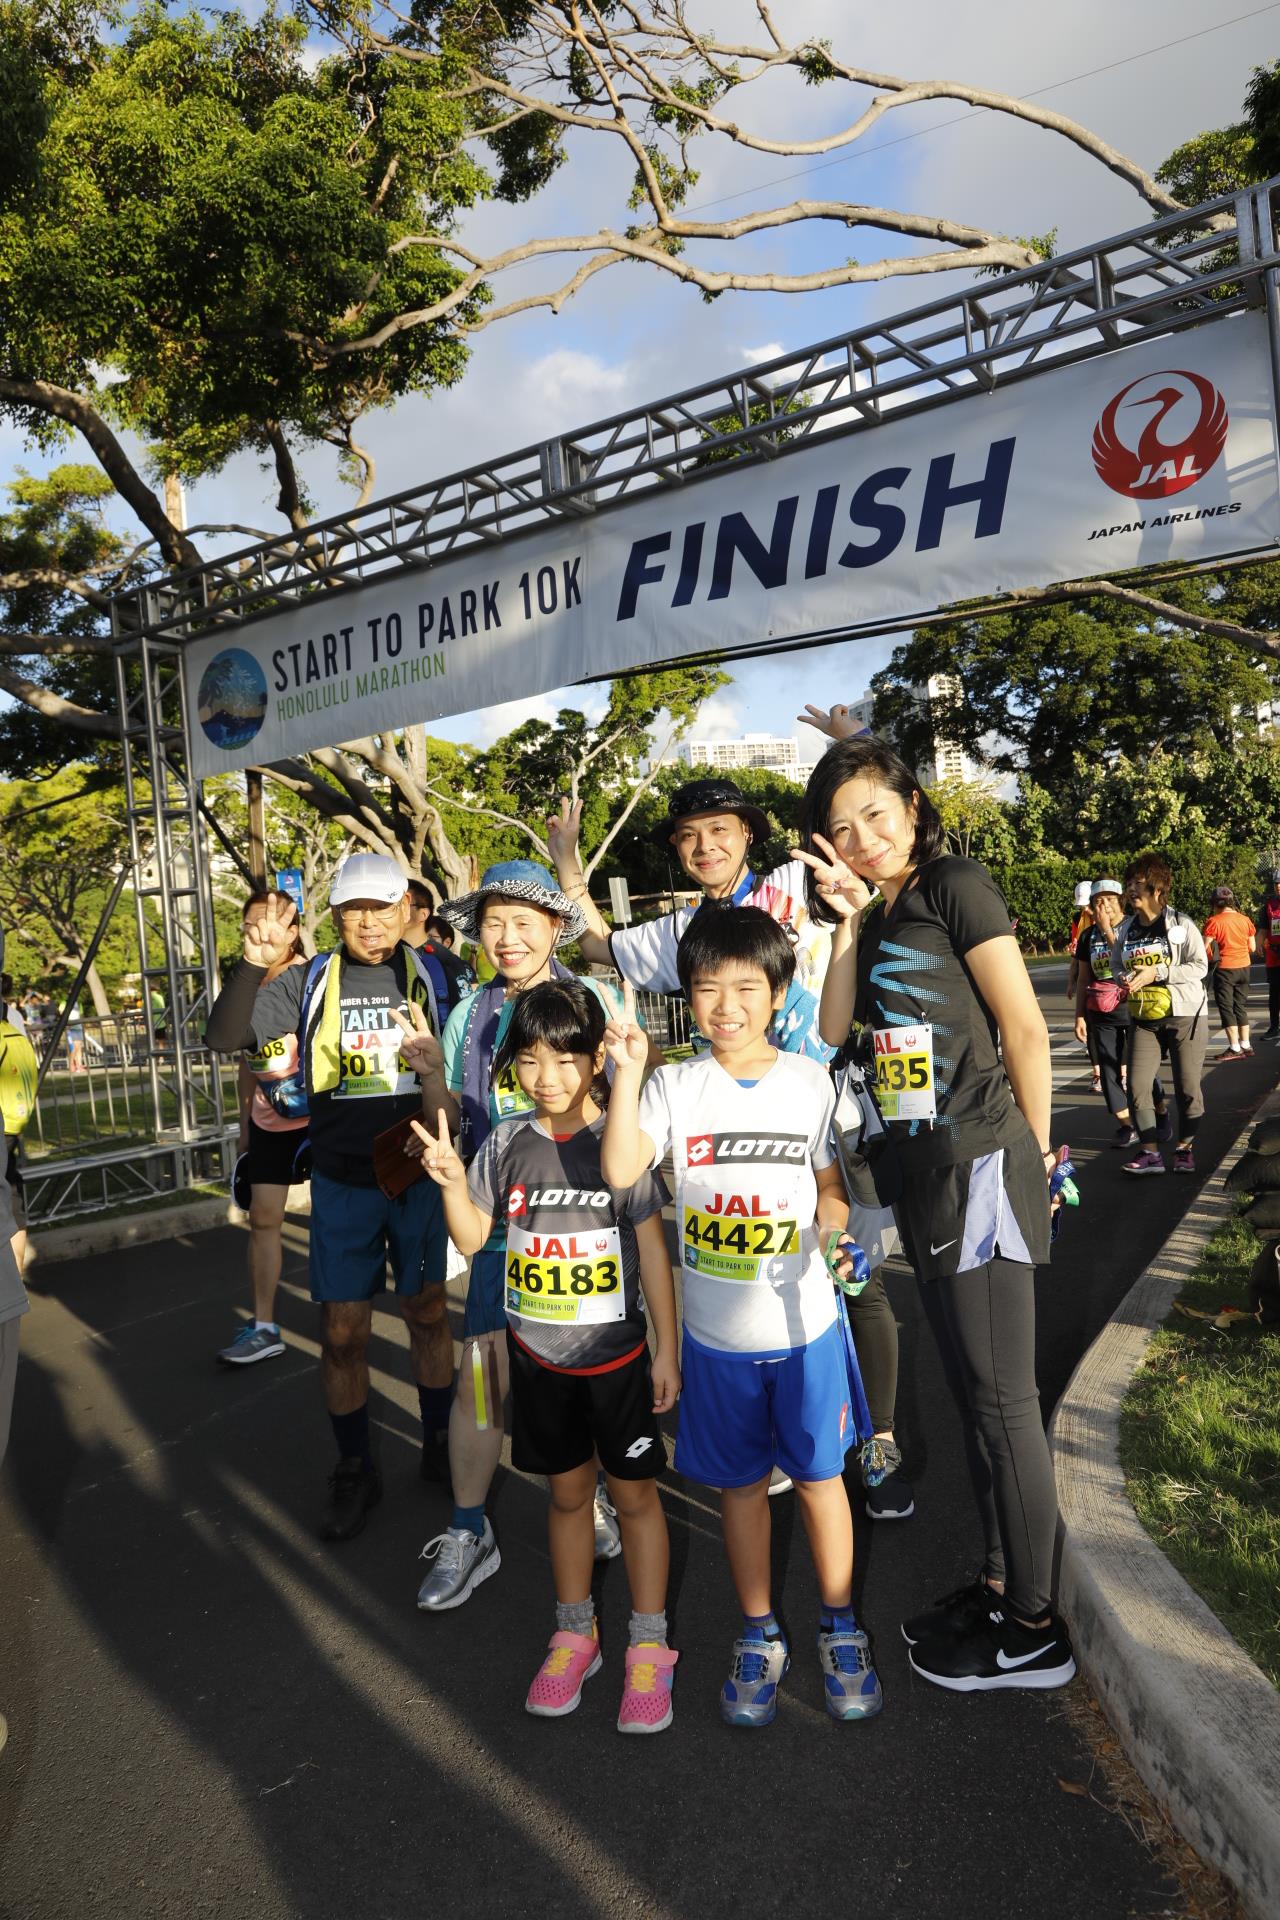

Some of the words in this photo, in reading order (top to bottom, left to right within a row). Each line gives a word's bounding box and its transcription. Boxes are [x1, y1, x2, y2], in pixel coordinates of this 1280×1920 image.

[1129, 454, 1202, 489] JAL
[616, 436, 1017, 622] FINISH
[1087, 520, 1146, 541] JAPAN
[1150, 502, 1242, 529] AIRLINES
[272, 626, 354, 692] START
[367, 612, 402, 663] TO
[418, 580, 502, 649] PARK
[518, 556, 582, 620] 10K
[276, 678, 349, 722] HONOLULU
[356, 651, 446, 698] MARATHON
[1129, 948, 1149, 959] JAL
[371, 996, 390, 1005] 2018
[717, 1139, 807, 1158] LOTTO
[529, 1189, 612, 1208] LOTTO
[704, 1193, 771, 1218] JAL
[685, 1214, 797, 1255] 44427
[524, 1236, 588, 1260] JAL
[507, 1258, 618, 1296] 46183
[725, 1262, 741, 1271] PARK
[546, 1303, 561, 1312] PARK
[564, 1304, 575, 1312] 10K
